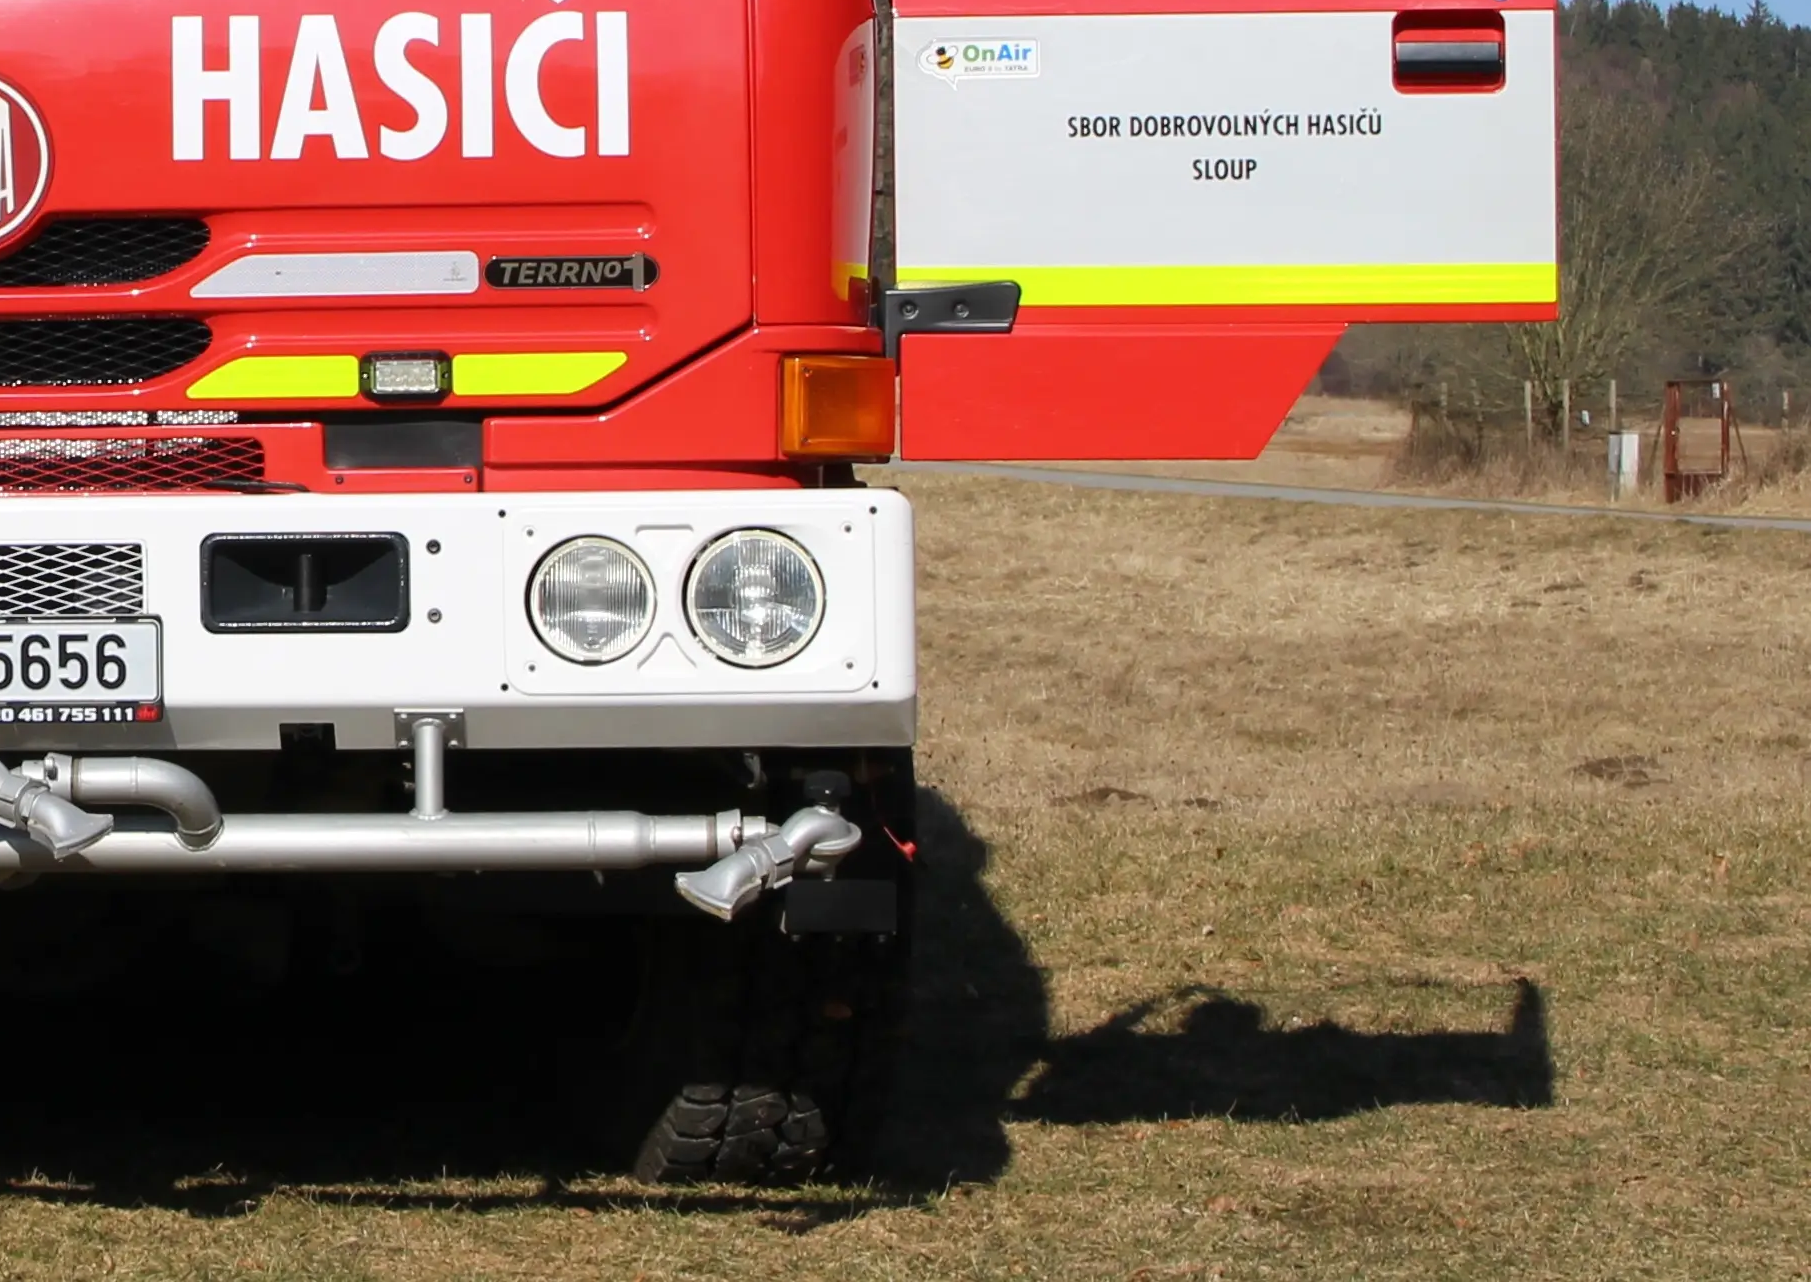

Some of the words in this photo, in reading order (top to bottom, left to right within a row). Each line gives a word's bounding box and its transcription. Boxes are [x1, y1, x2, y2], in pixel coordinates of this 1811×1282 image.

[962, 44, 1032, 63] OnAir
[1067, 116, 1121, 138] SBOR
[1130, 109, 1299, 137] DOBROVOLNÝCH
[1307, 108, 1382, 136] HASIČŮ
[1192, 158, 1257, 181] SLOUP
[18, 707, 53, 722] 461
[58, 707, 97, 722] 755
[102, 707, 133, 721] 111
